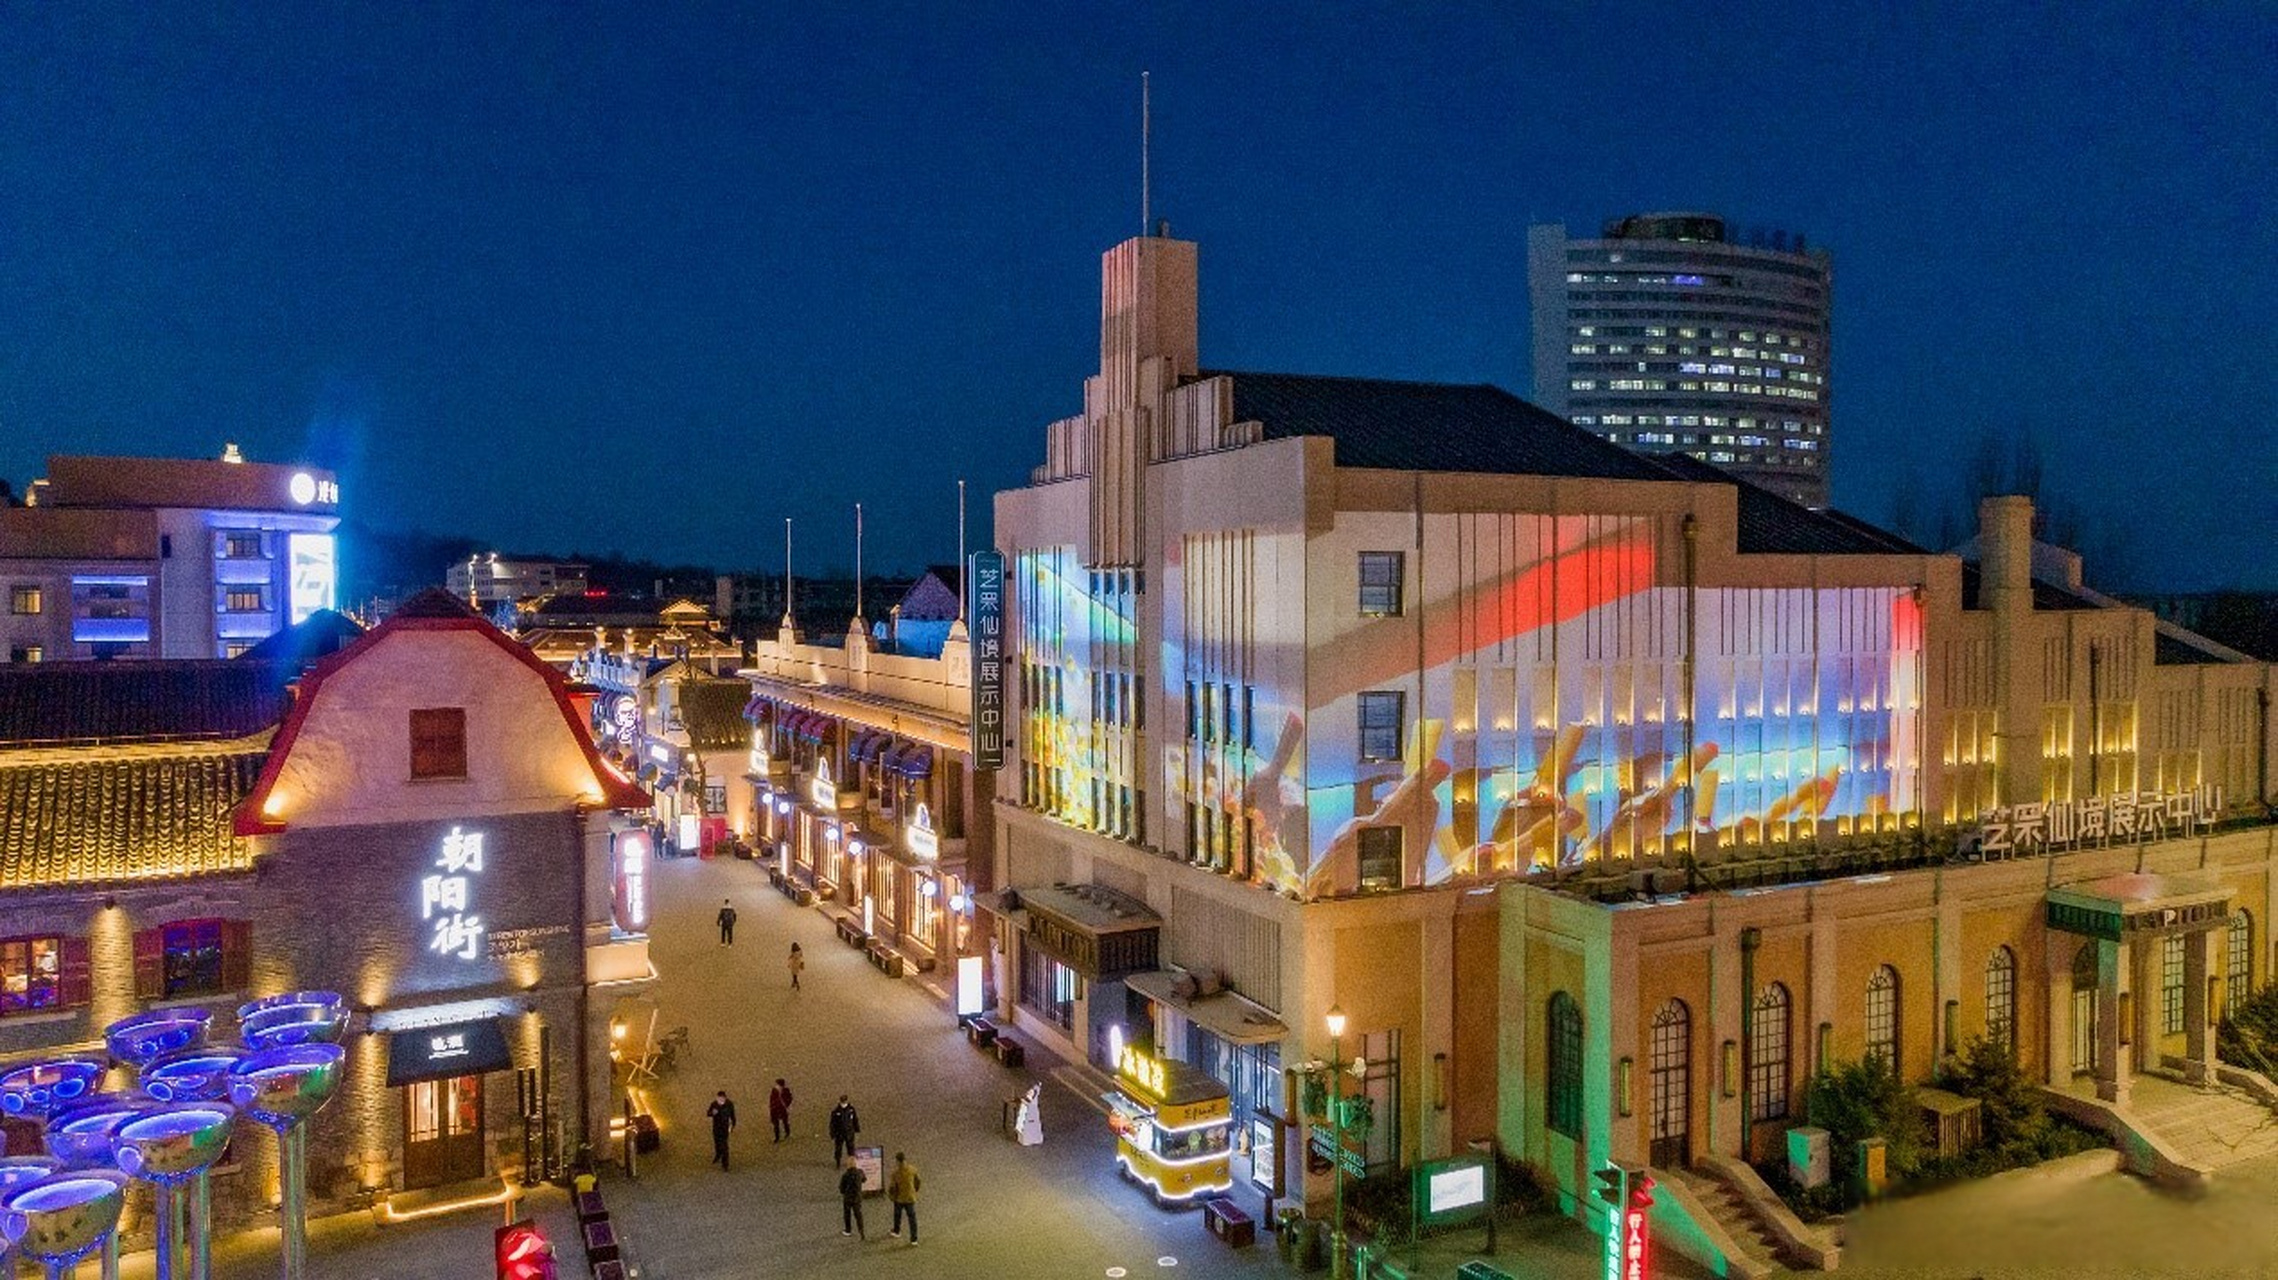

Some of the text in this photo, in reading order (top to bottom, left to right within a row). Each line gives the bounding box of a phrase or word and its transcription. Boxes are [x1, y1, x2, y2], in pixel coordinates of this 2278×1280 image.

[979, 567, 1000, 752] 芝罘仙境展示中心
[1979, 783, 2222, 849] 芝罘仙境展示中心
[422, 826, 484, 960] 朝阳街
